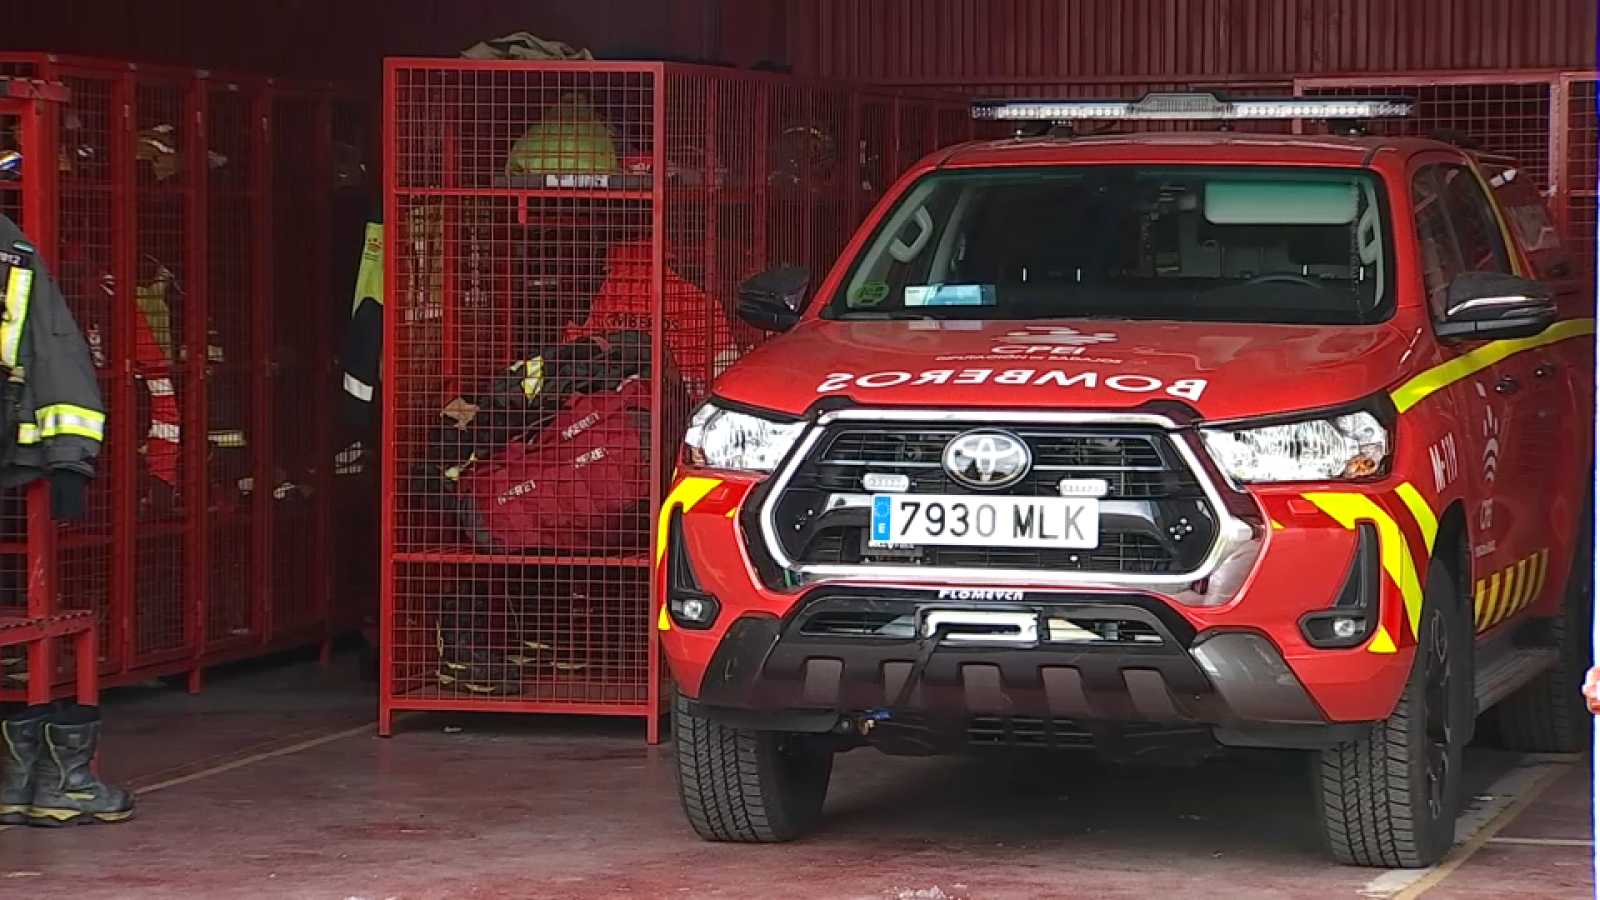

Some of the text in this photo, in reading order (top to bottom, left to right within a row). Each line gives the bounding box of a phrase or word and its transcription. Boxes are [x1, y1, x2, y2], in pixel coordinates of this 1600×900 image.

[991, 345, 1086, 354] CPEI
[900, 502, 1086, 541] 7930 MLK
[877, 522, 886, 534] E
